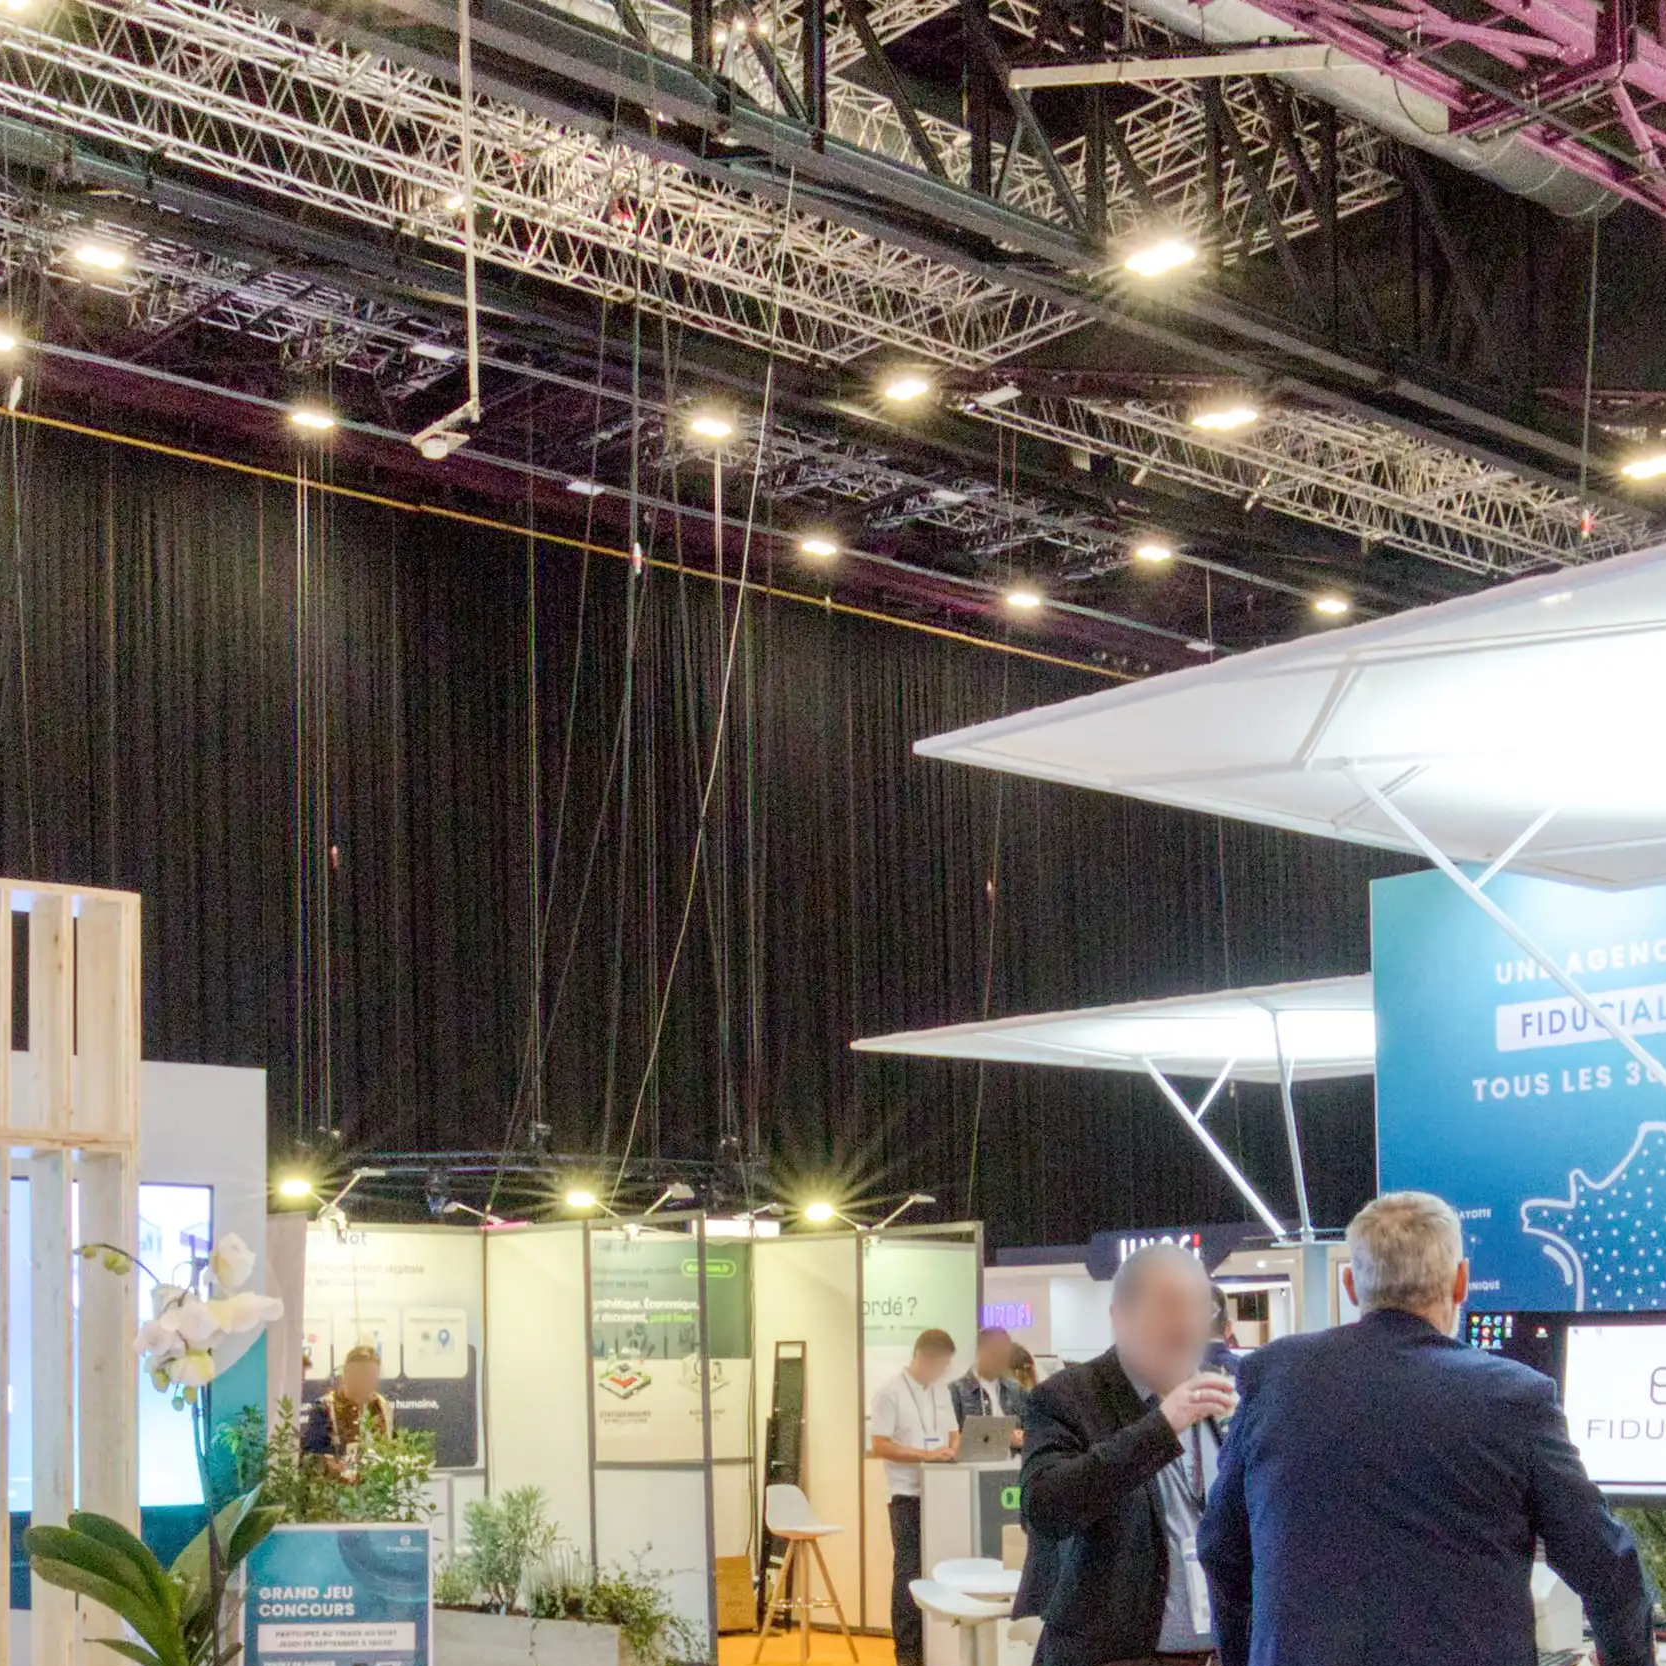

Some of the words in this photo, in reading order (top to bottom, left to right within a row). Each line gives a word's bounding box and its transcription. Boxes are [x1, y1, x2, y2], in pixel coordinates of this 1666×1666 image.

[1472, 1072, 1550, 1101] TOUS
[1562, 1065, 1612, 1093] LES
[259, 1587, 320, 1601] GRAND
[323, 1586, 354, 1599] JEU
[259, 1603, 355, 1617] CONCOURS
